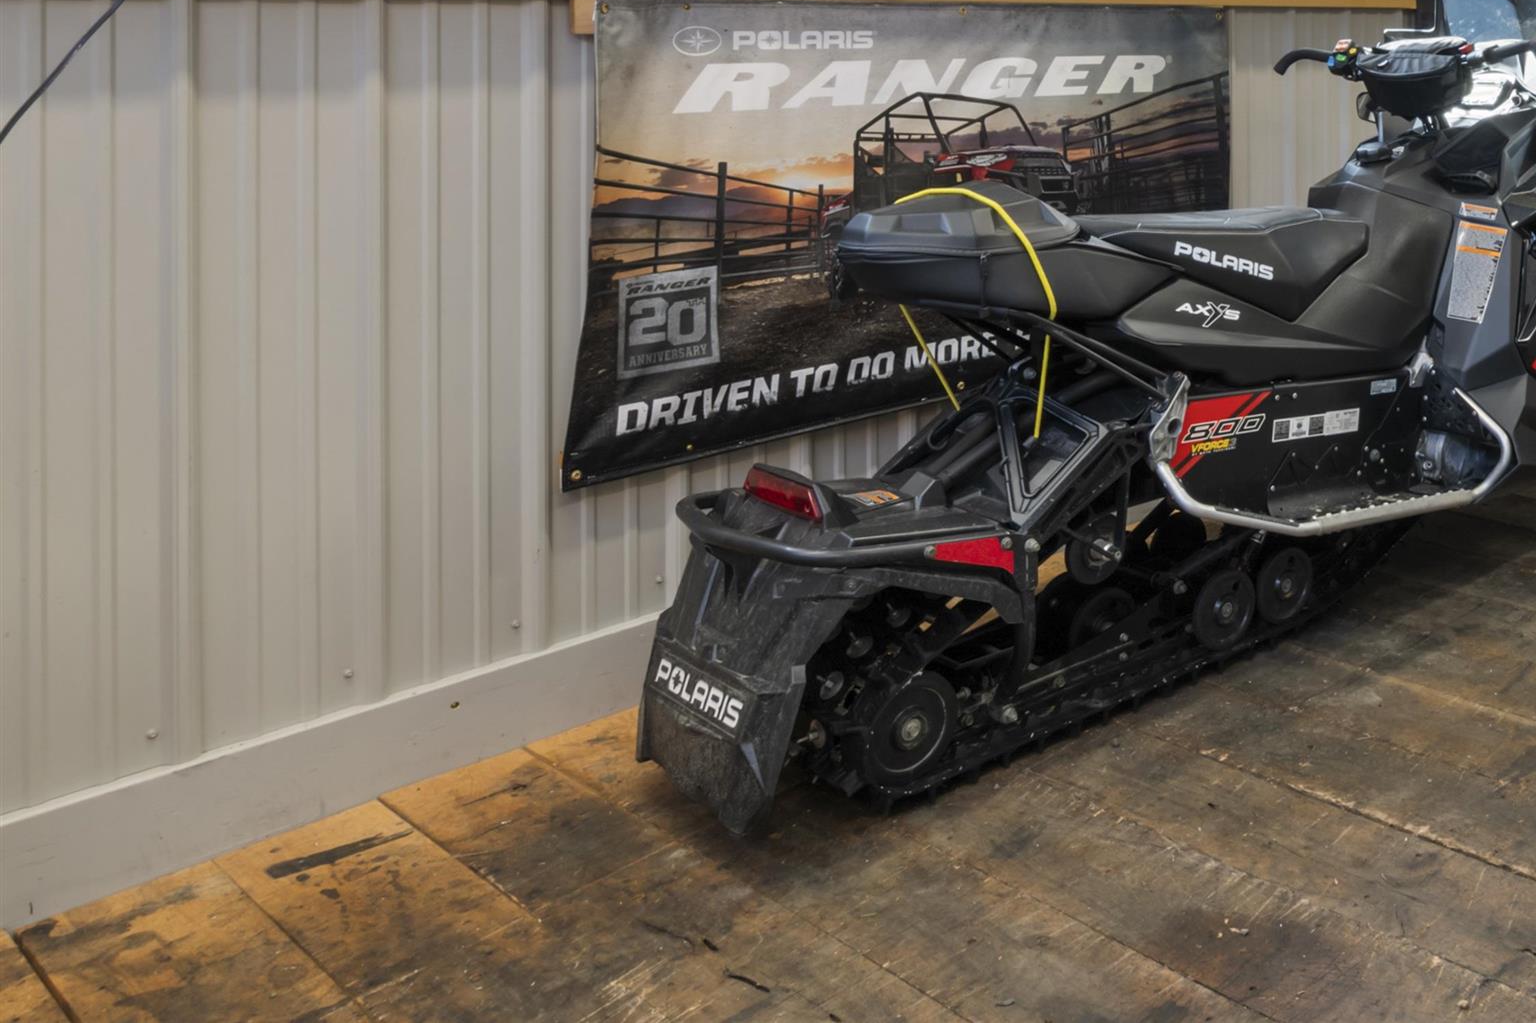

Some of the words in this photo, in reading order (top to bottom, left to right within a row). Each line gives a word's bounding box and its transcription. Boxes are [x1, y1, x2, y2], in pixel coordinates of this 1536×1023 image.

[733, 30, 873, 51] POLARIS
[672, 55, 1167, 115] RANGER
[1174, 241, 1274, 281] POLARIS
[627, 277, 712, 296] RANGER
[629, 296, 706, 347] 20
[1175, 301, 1241, 328] AXYS
[629, 344, 708, 368] ANNIVERSARY
[616, 373, 780, 437] DRIVEN
[790, 363, 837, 399] TO
[847, 351, 896, 385] DO
[1182, 413, 1266, 443] 800
[654, 657, 744, 730] POLARIS
